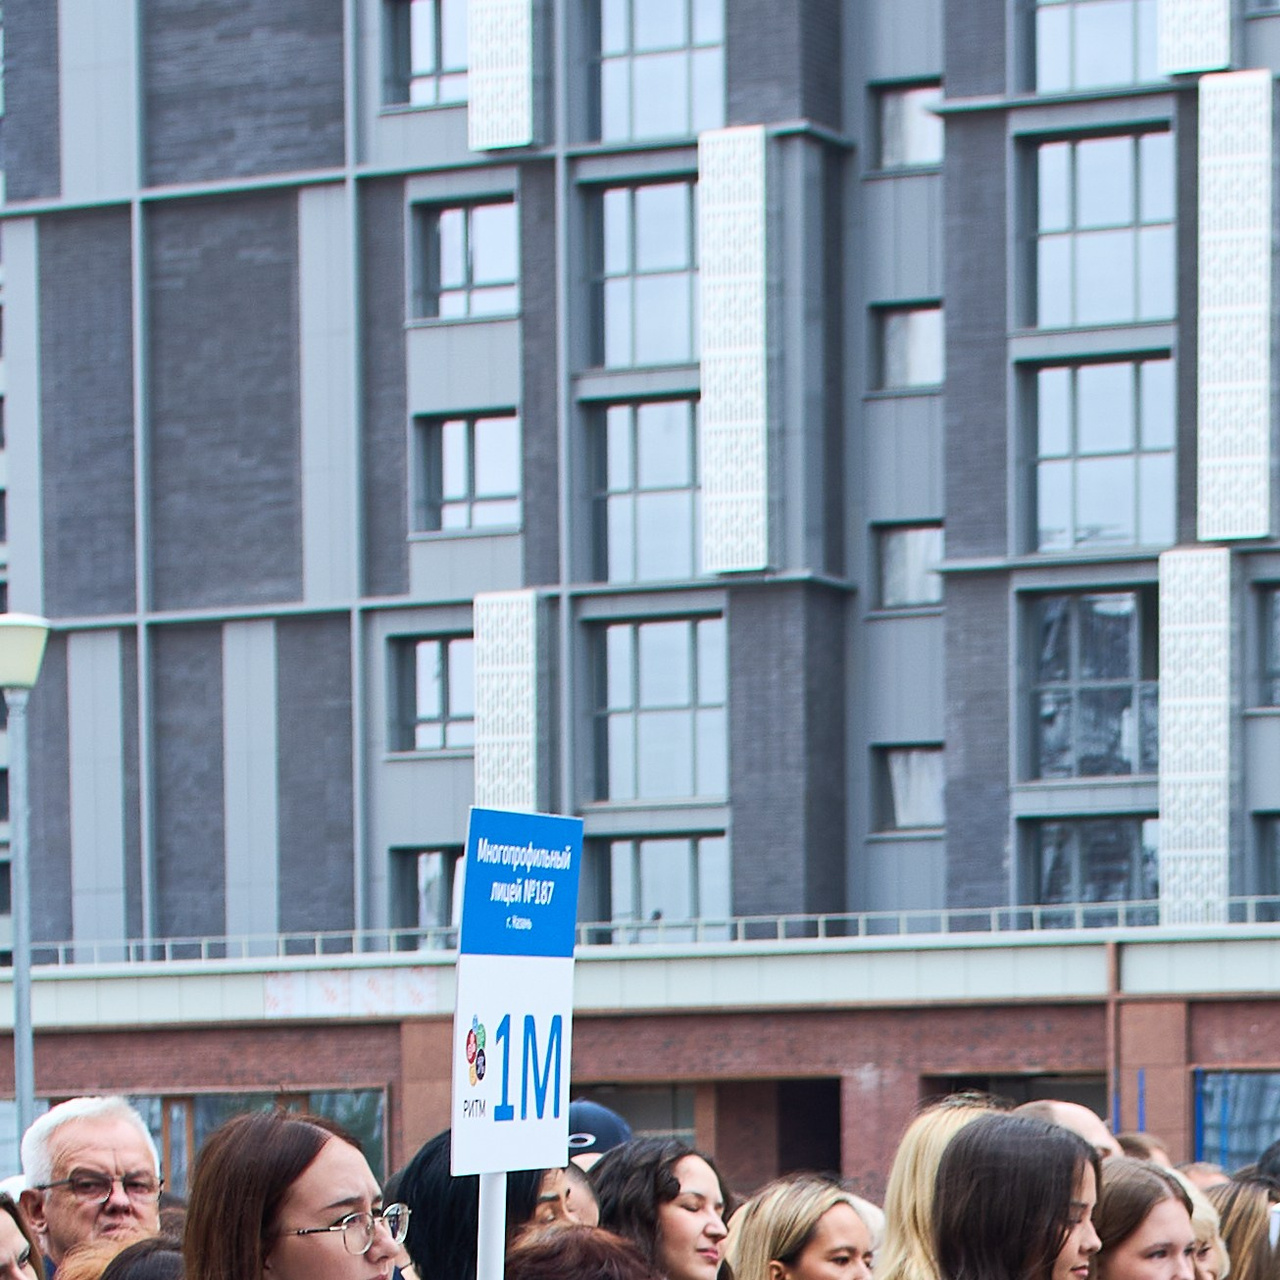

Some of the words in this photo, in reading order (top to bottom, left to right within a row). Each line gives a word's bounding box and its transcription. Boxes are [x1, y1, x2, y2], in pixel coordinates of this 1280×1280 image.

[477, 837, 572, 874] Многопрофильный
[490, 878, 522, 908] лицей
[523, 878, 555, 906] №187
[463, 1099, 486, 1119] РИТМ
